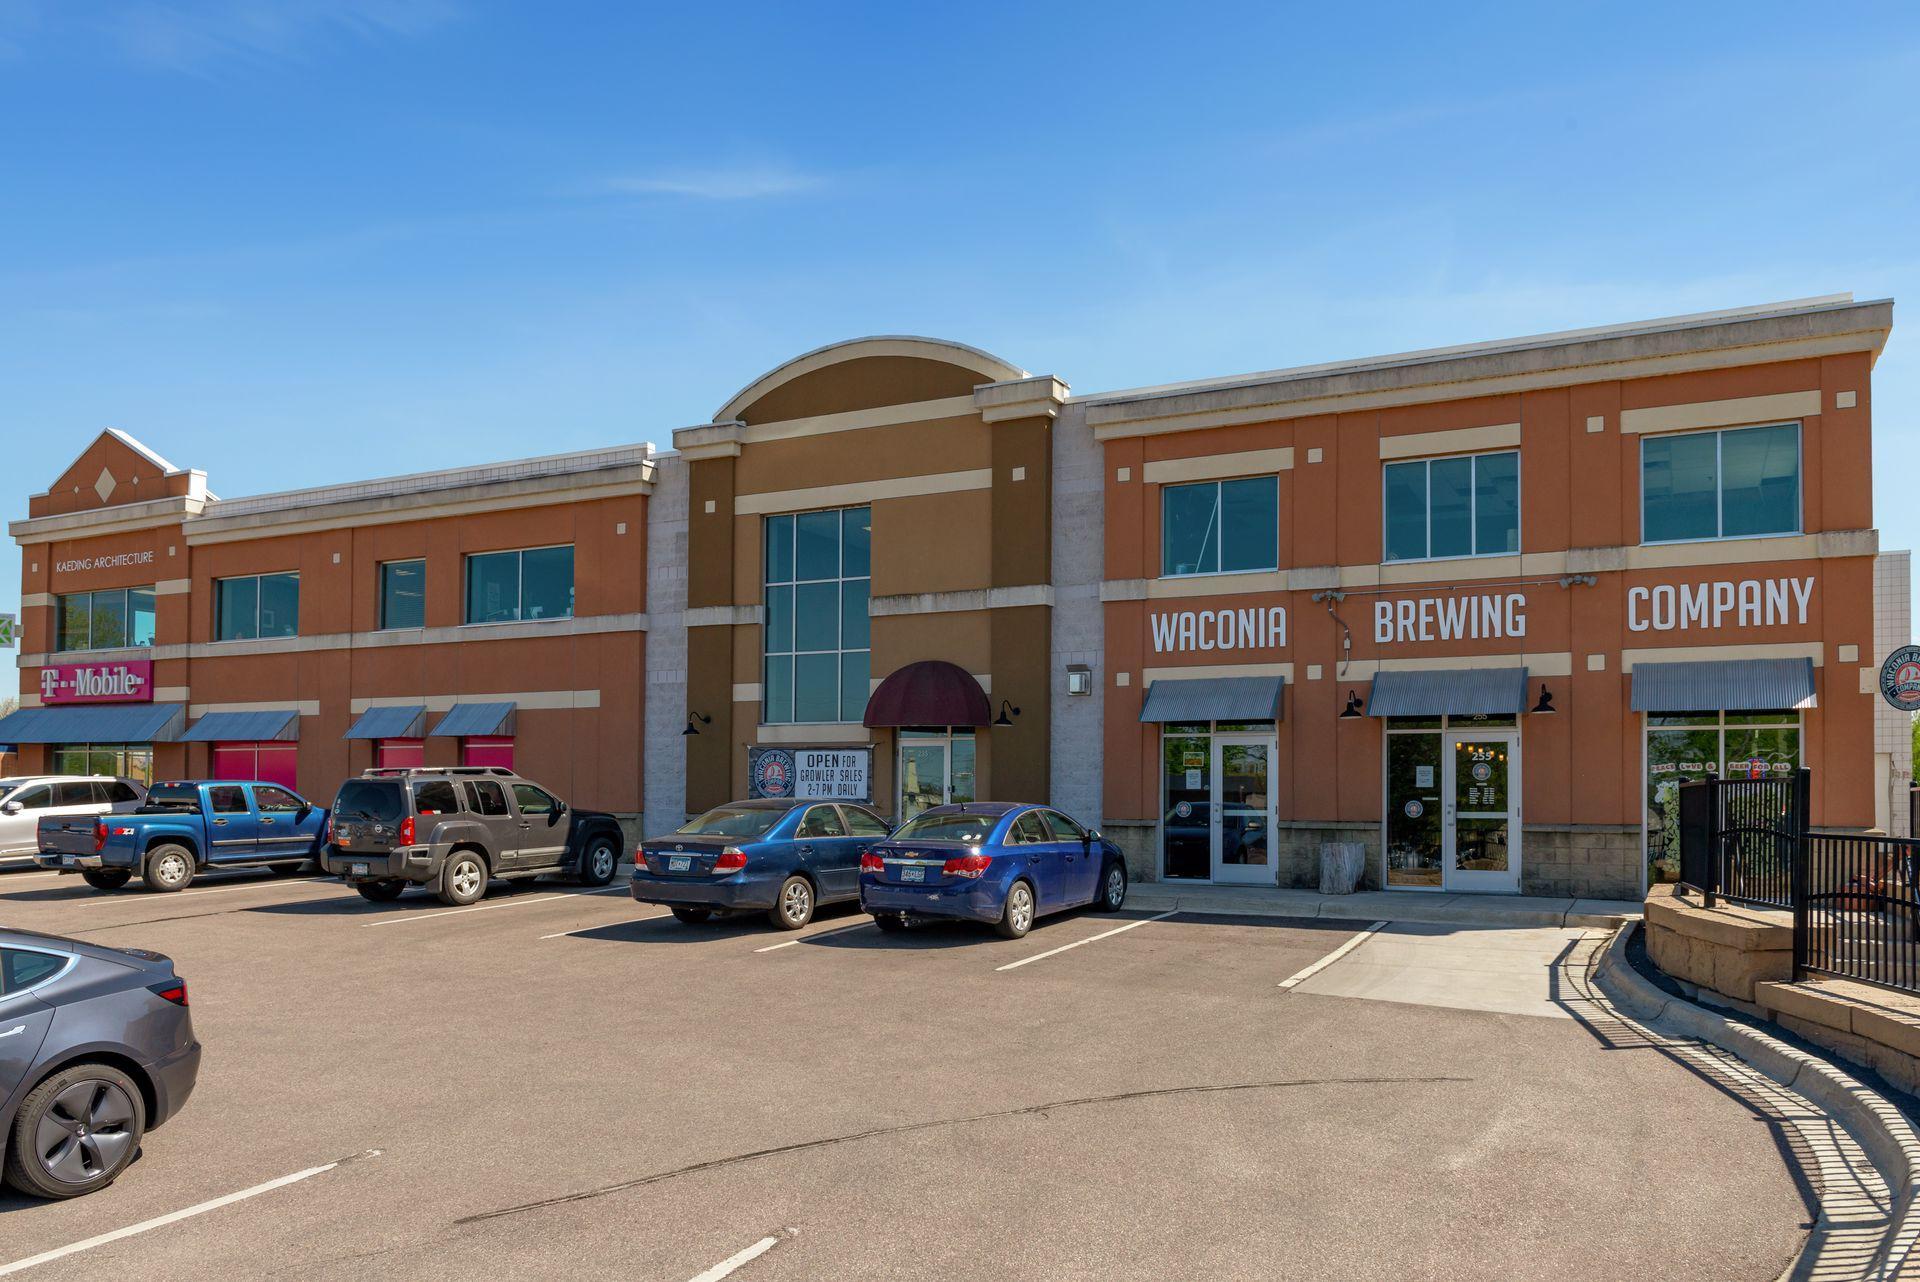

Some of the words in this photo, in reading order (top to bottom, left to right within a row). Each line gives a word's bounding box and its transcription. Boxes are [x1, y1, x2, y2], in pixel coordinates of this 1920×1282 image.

[56, 559, 92, 573] KAEDING
[93, 551, 154, 569] ARCHITECTURE
[1150, 606, 1288, 653] WACONIA
[1373, 593, 1527, 643] BREWING
[1628, 576, 1815, 632] COMPANY
[807, 754, 839, 768] OPEN
[842, 755, 857, 768] FOR
[1471, 751, 1492, 761] 255
[800, 769, 835, 782] GROWLER
[839, 769, 863, 782] SALES
[807, 783, 820, 796] 2-7
[822, 783, 833, 796] PM
[837, 783, 858, 796] DAILY
